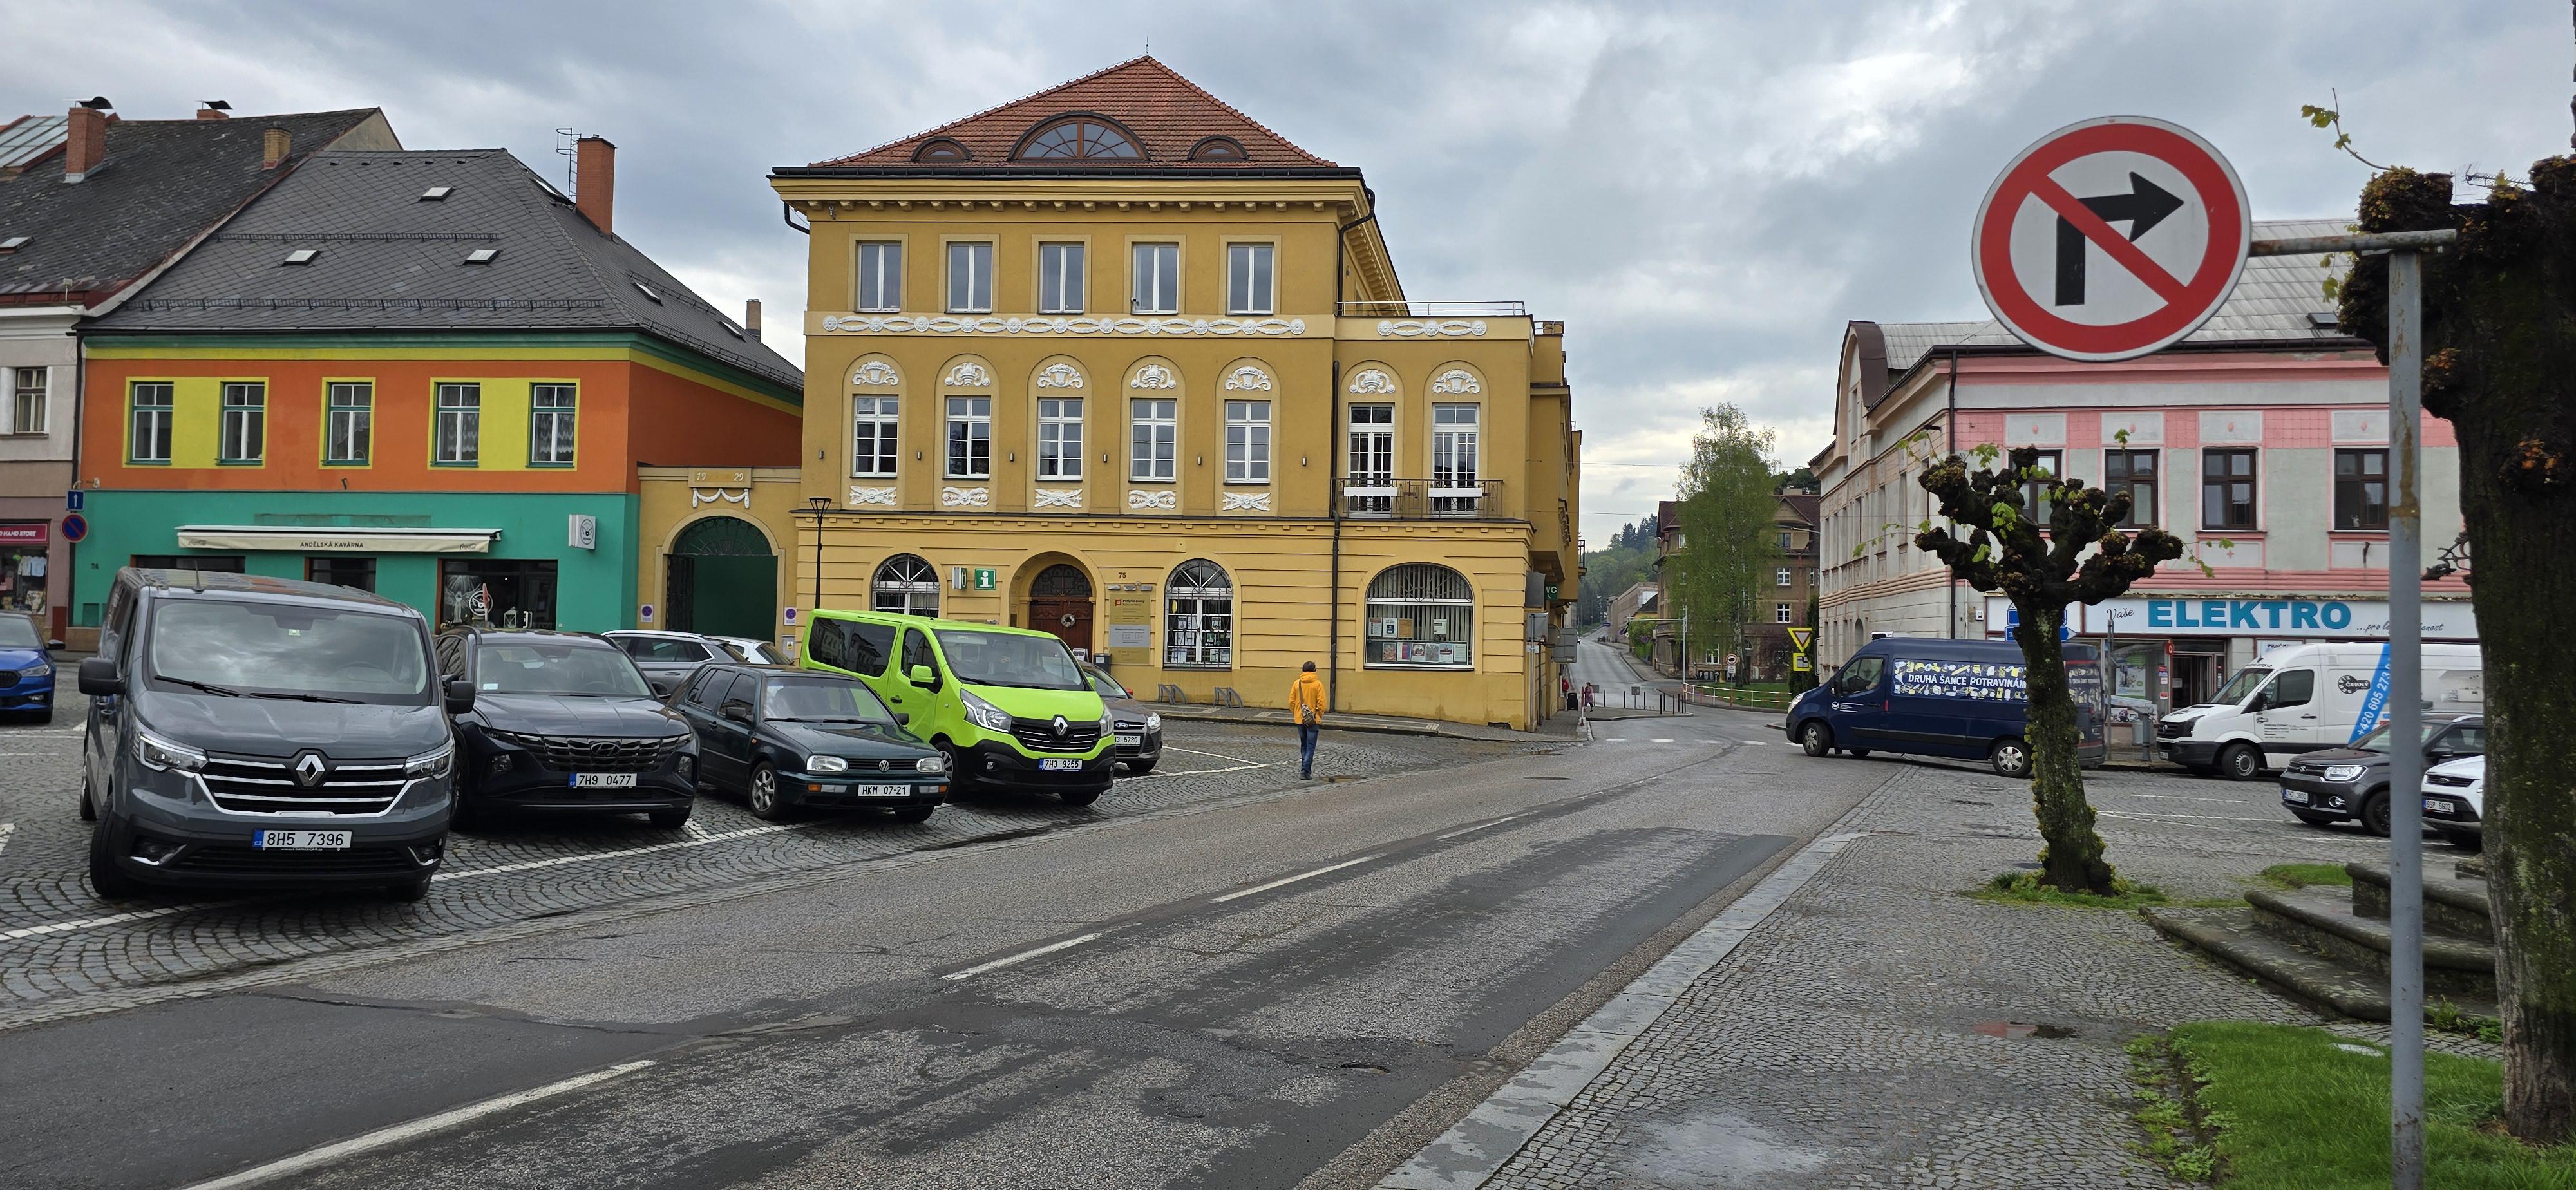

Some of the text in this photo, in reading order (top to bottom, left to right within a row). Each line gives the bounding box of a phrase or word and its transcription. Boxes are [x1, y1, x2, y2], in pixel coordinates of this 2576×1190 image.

[696, 472, 744, 482] 19 29
[2106, 601, 2352, 629] Vaše ELEKTRO
[1908, 674, 1937, 684] DRUHÁ
[1939, 675, 1967, 686] ŠANCE
[2358, 711, 2374, 735] +420
[2368, 690, 2383, 710] 605
[1045, 760, 1057, 768] 7H3
[578, 775, 632, 785] 7H9 0477
[862, 786, 906, 795] HKM 07-21
[267, 833, 345, 847] 8H5 7396
